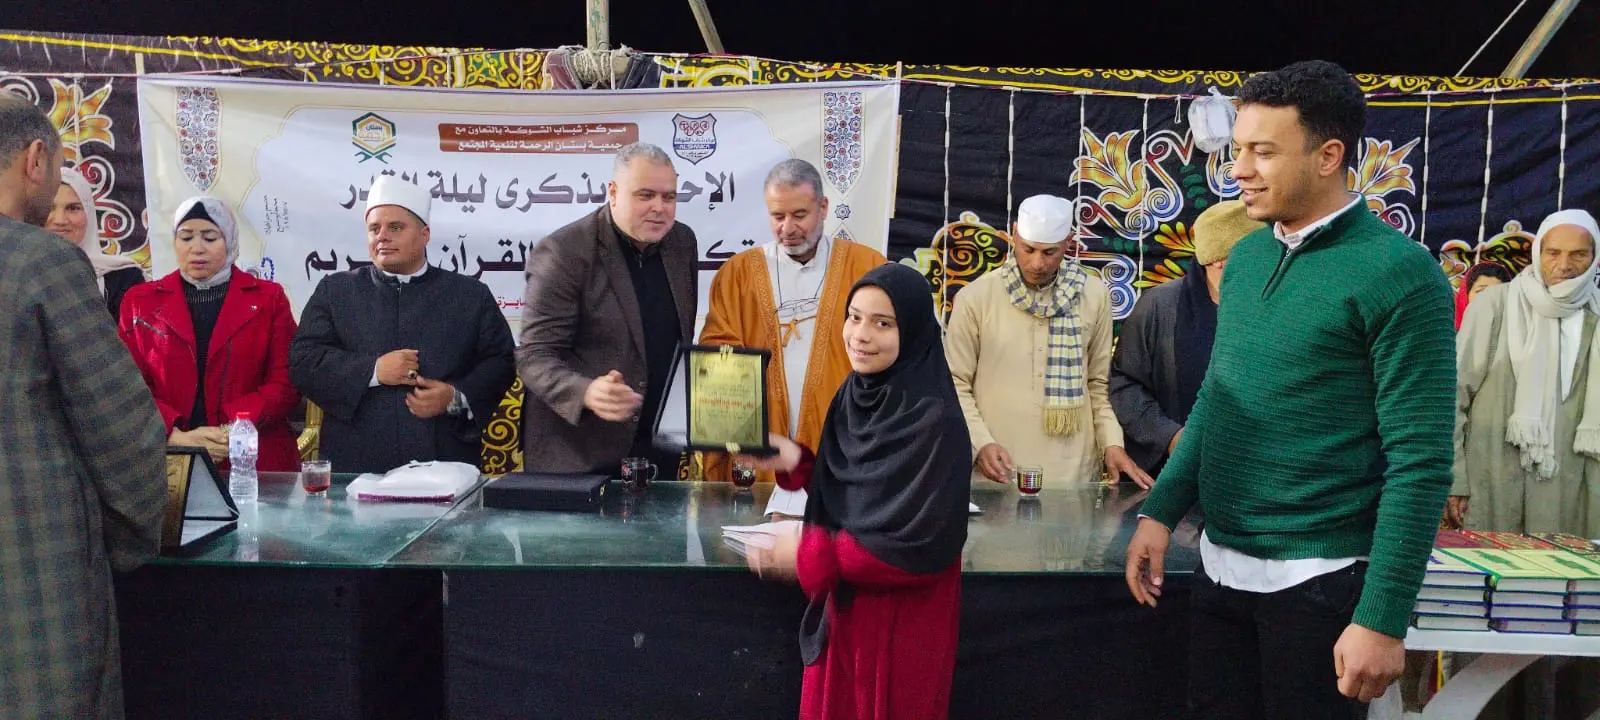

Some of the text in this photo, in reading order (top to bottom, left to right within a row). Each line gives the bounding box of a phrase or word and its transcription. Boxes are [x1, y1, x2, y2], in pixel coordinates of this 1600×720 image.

[455, 125, 627, 136] مركز شباب الشوكة بالتعاون مع
[458, 140, 622, 152] جمعية بستان الرحمة لتنمية المجتمع
[429, 170, 488, 214] ليلة
